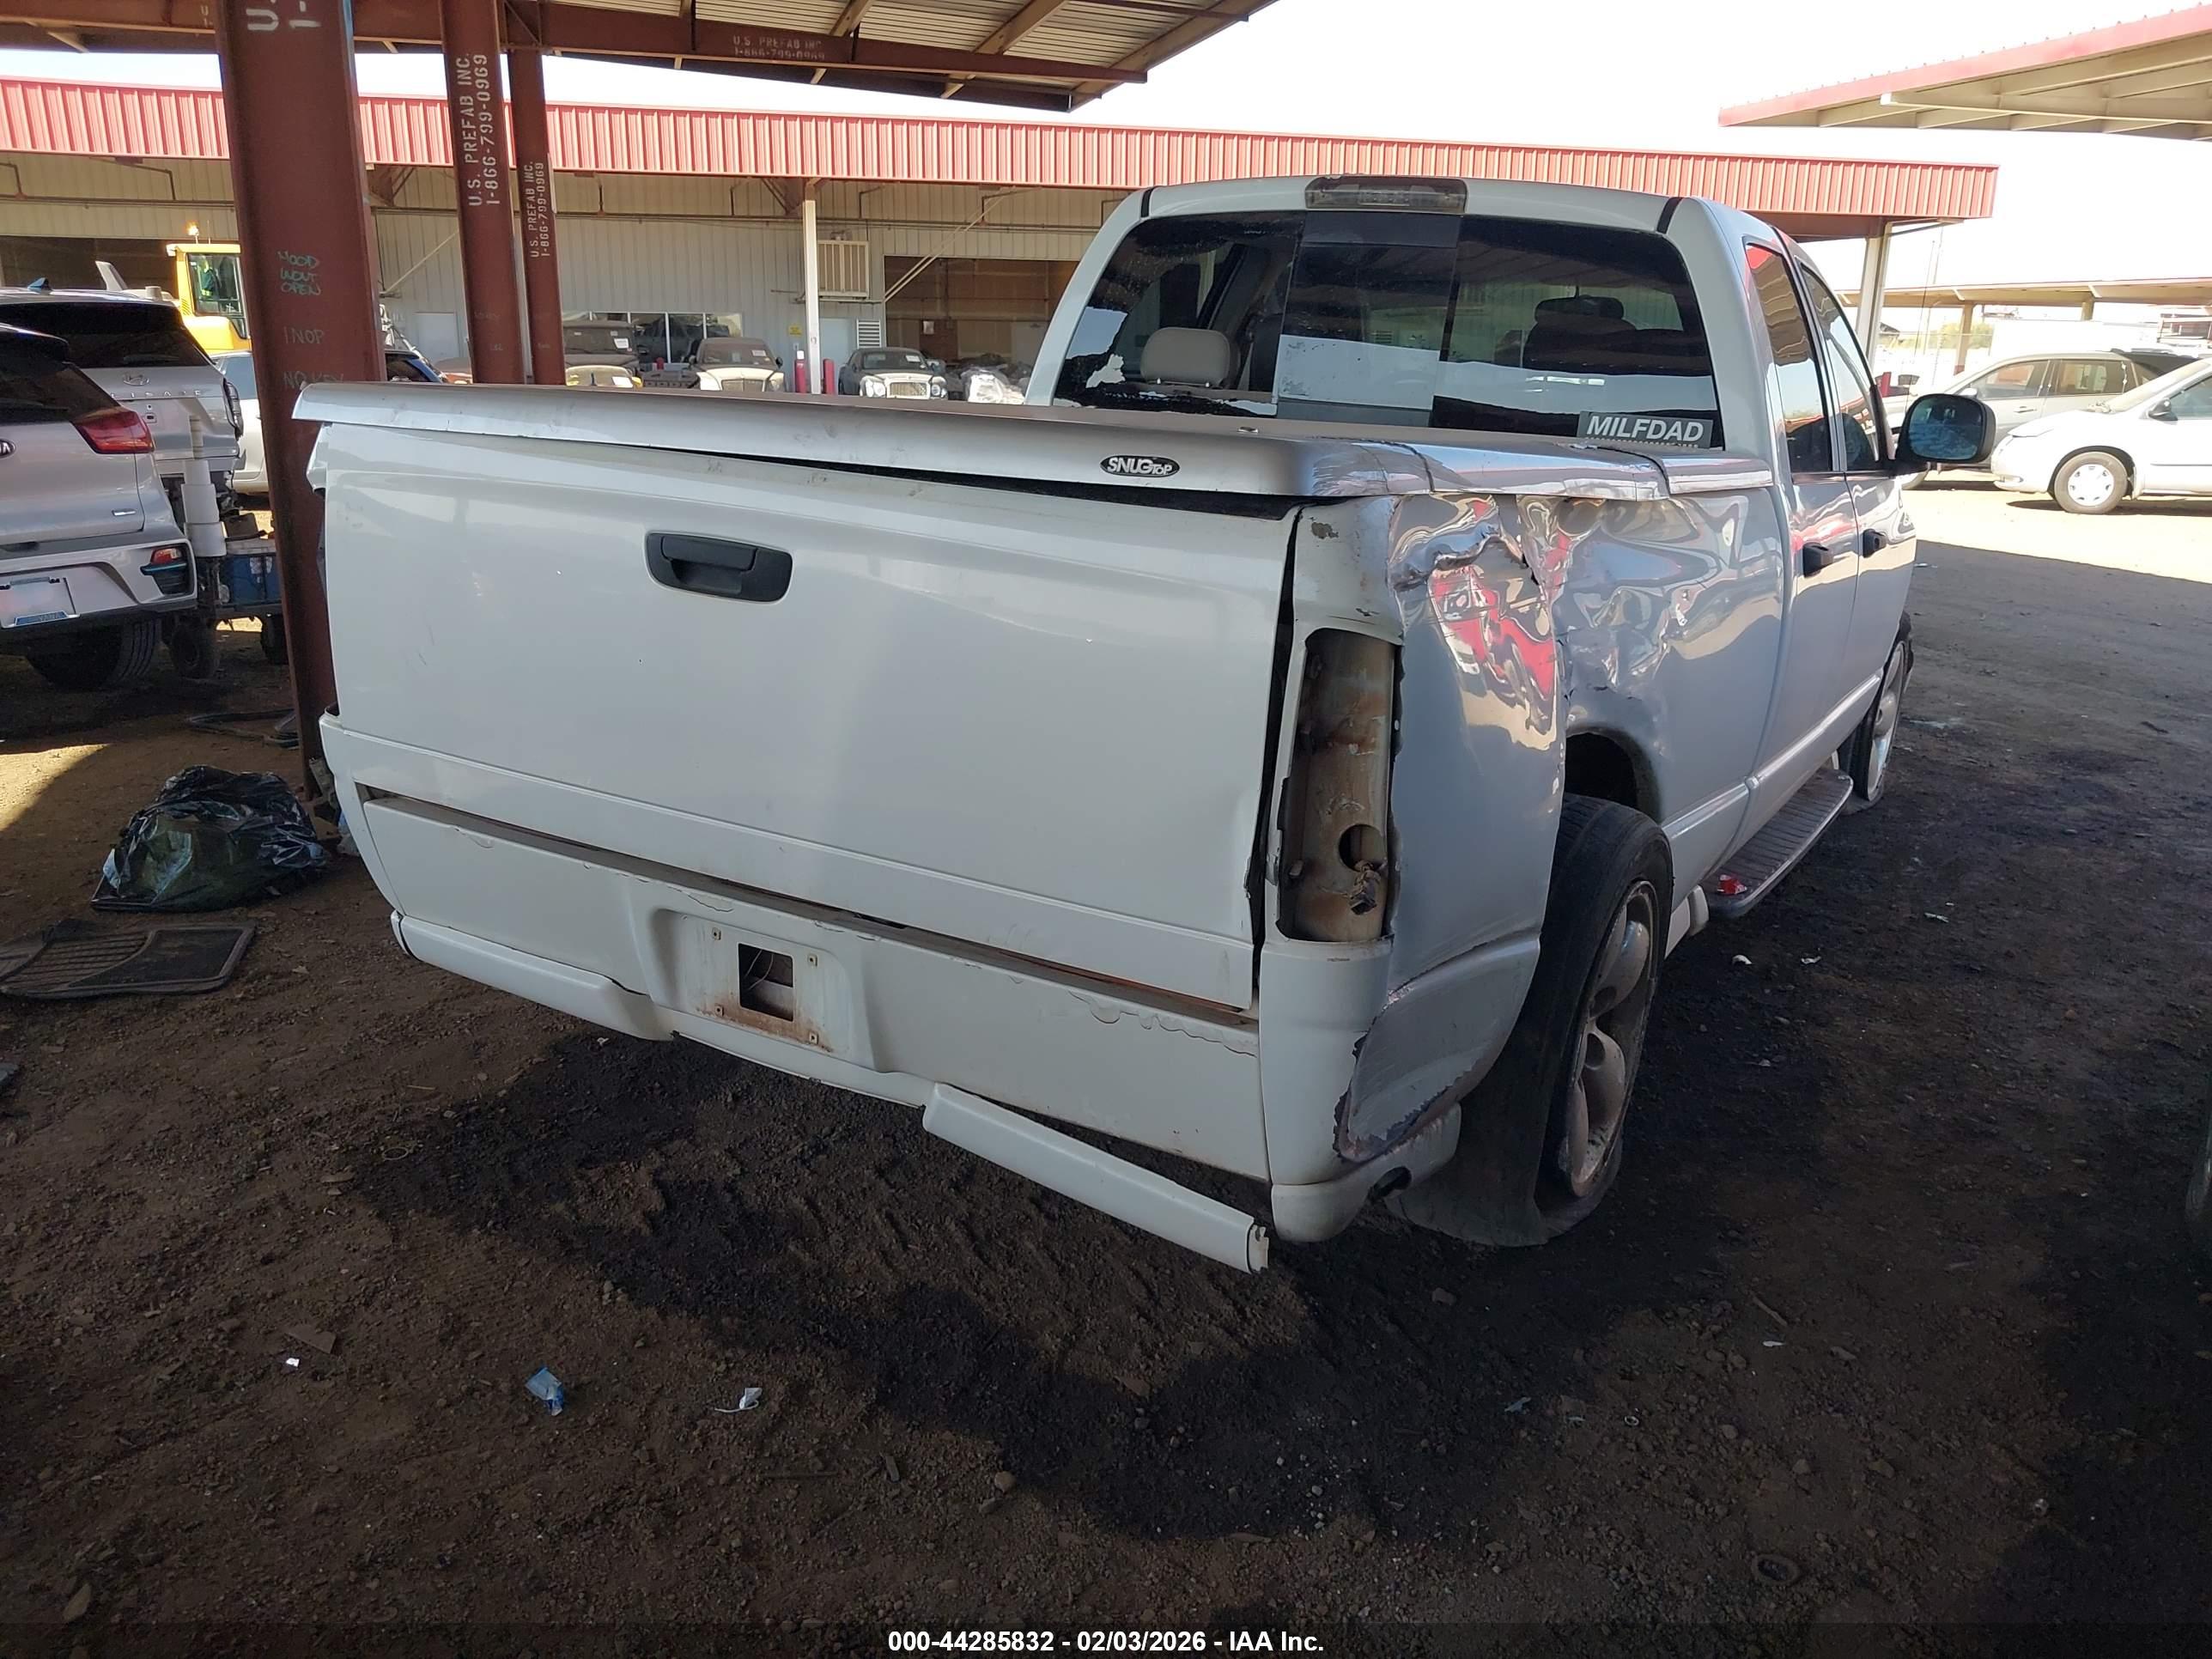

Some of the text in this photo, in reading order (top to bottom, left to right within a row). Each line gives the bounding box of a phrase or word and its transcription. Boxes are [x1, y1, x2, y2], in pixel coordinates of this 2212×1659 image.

[459, 95, 479, 163] PREFAB
[473, 54, 501, 205] 1-866-799-0969
[467, 173, 483, 206] U.S.
[525, 188, 538, 231] PREFAB
[535, 162, 550, 257] 1-866-799-0969
[530, 236, 539, 258] U.S.
[1586, 416, 1704, 441] MILFDAD
